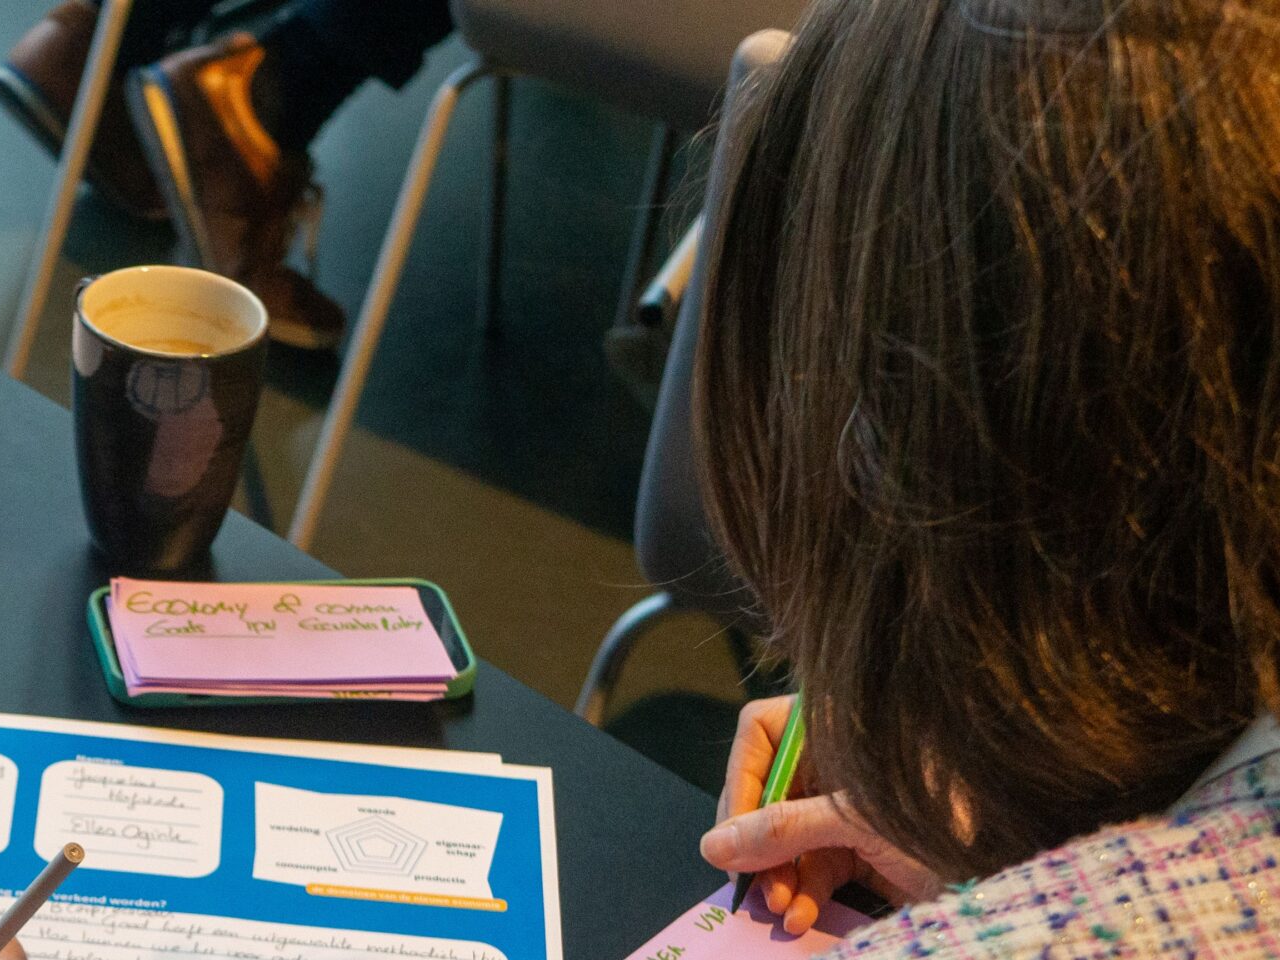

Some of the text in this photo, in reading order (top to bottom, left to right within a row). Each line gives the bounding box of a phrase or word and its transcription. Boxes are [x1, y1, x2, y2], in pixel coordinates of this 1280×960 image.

[270, 824, 320, 835] verdeling
[276, 861, 338, 873] consumptie
[414, 874, 466, 884] productie
